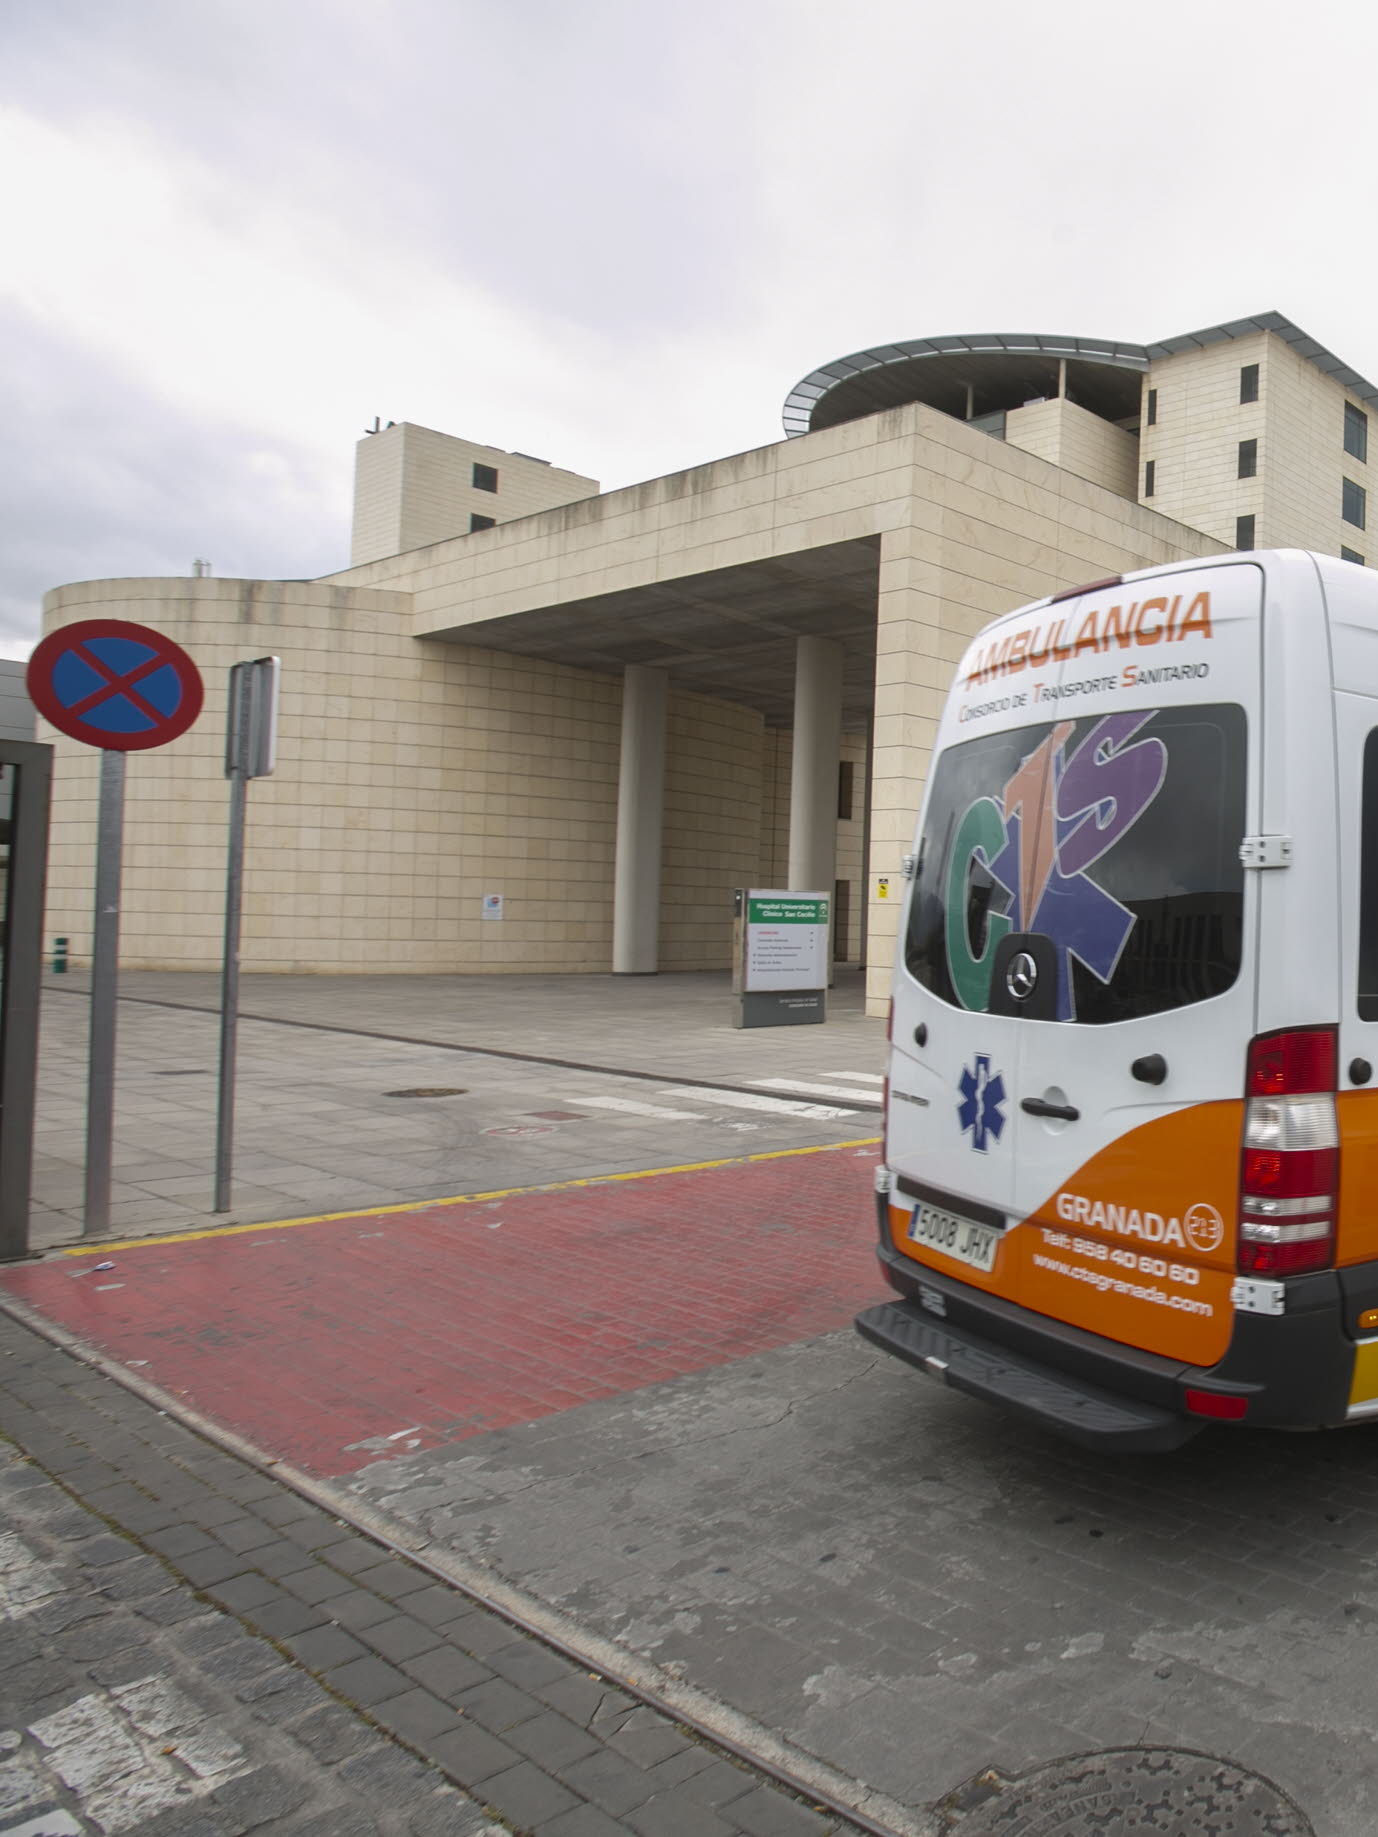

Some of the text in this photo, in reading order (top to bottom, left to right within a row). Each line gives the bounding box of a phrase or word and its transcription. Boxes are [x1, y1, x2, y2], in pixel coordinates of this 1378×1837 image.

[965, 591, 1213, 691] AMBULANCIA
[1011, 693, 1028, 708] DE
[1033, 675, 1118, 703] TRANSPORTE
[1122, 663, 1209, 687] SANITARIO
[1057, 1193, 1186, 1248] GRANADA
[1072, 1239, 1109, 1261] 958
[1110, 1249, 1137, 1269] 40
[1138, 1256, 1168, 1278] 60
[1169, 1264, 1200, 1286] 60
